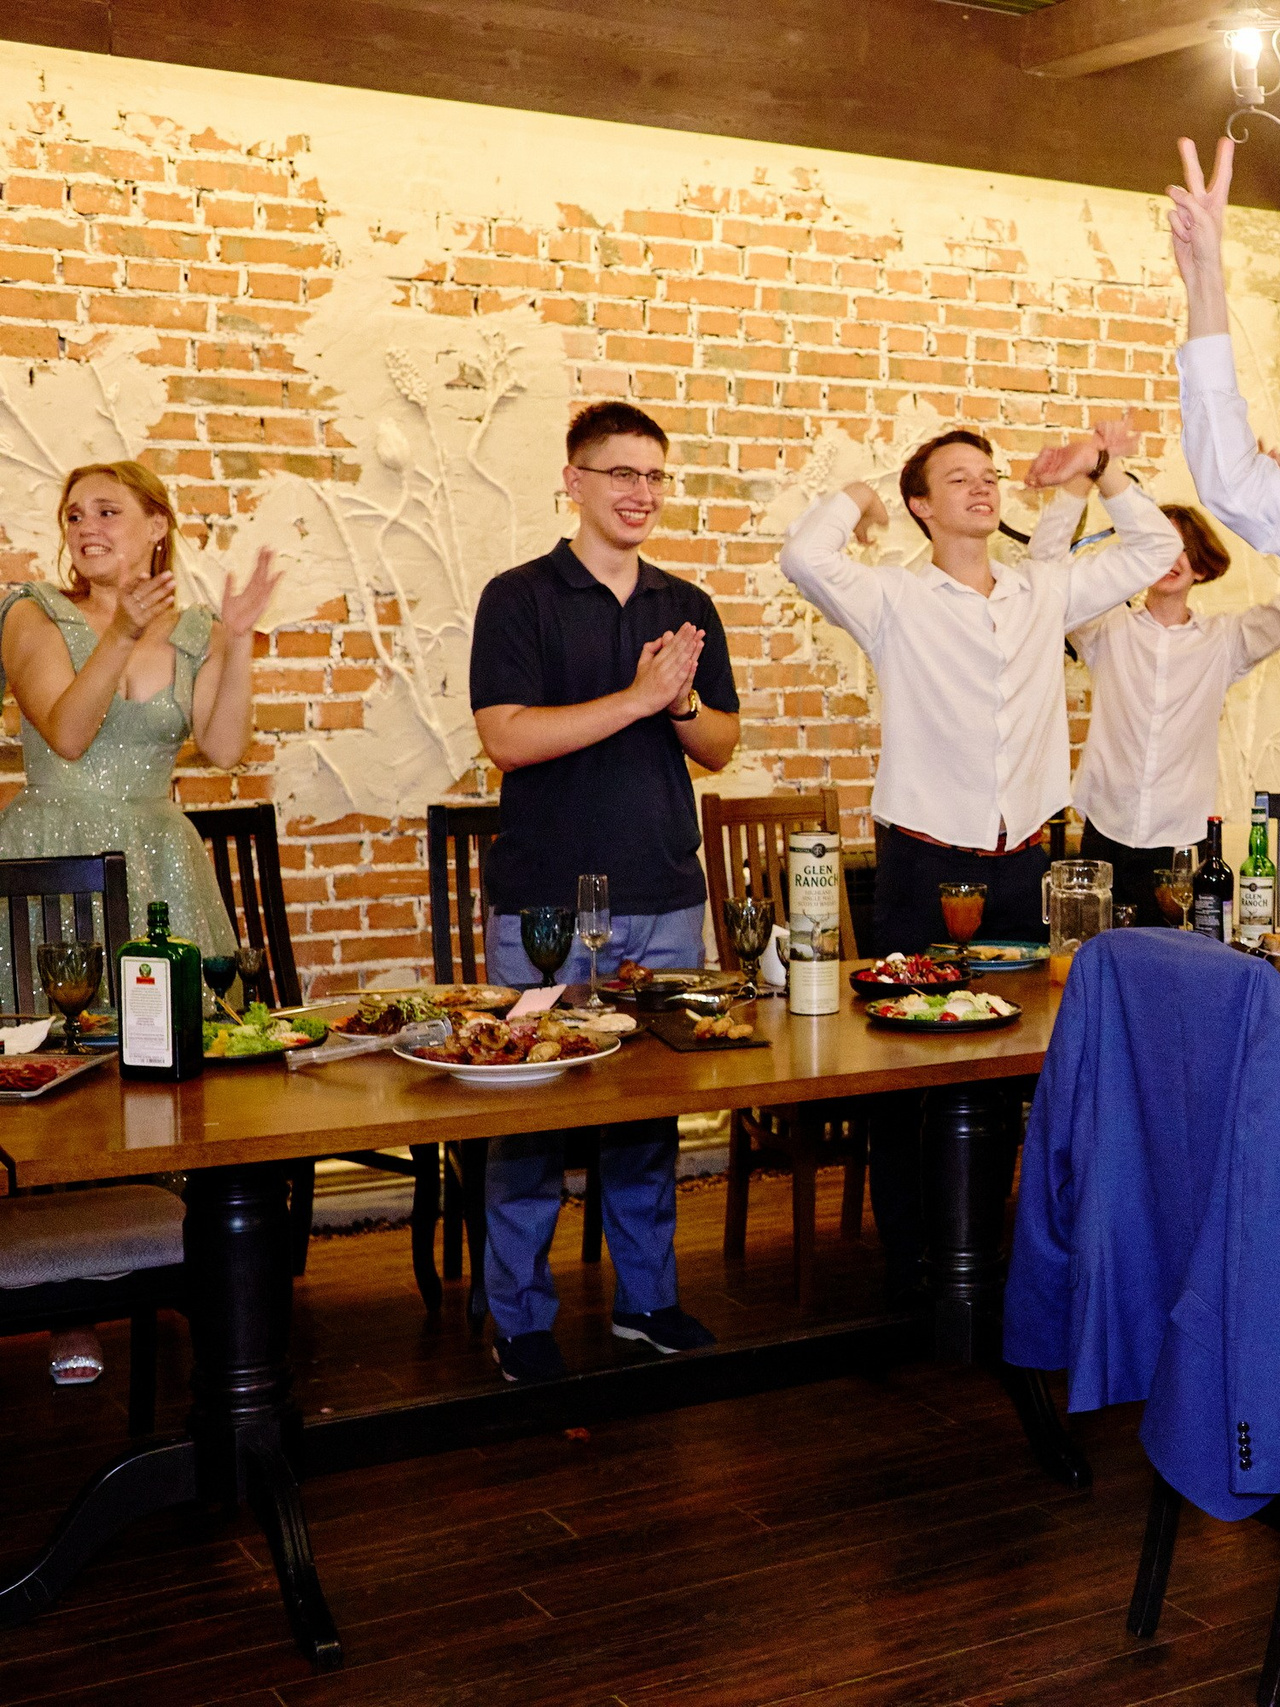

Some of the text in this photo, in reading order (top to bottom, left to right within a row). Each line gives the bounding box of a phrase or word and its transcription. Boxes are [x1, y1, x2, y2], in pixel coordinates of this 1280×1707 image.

[803, 865, 833, 875] GLEN
[795, 873, 839, 887] RANOCH
[1241, 898, 1268, 907] RANOCH
